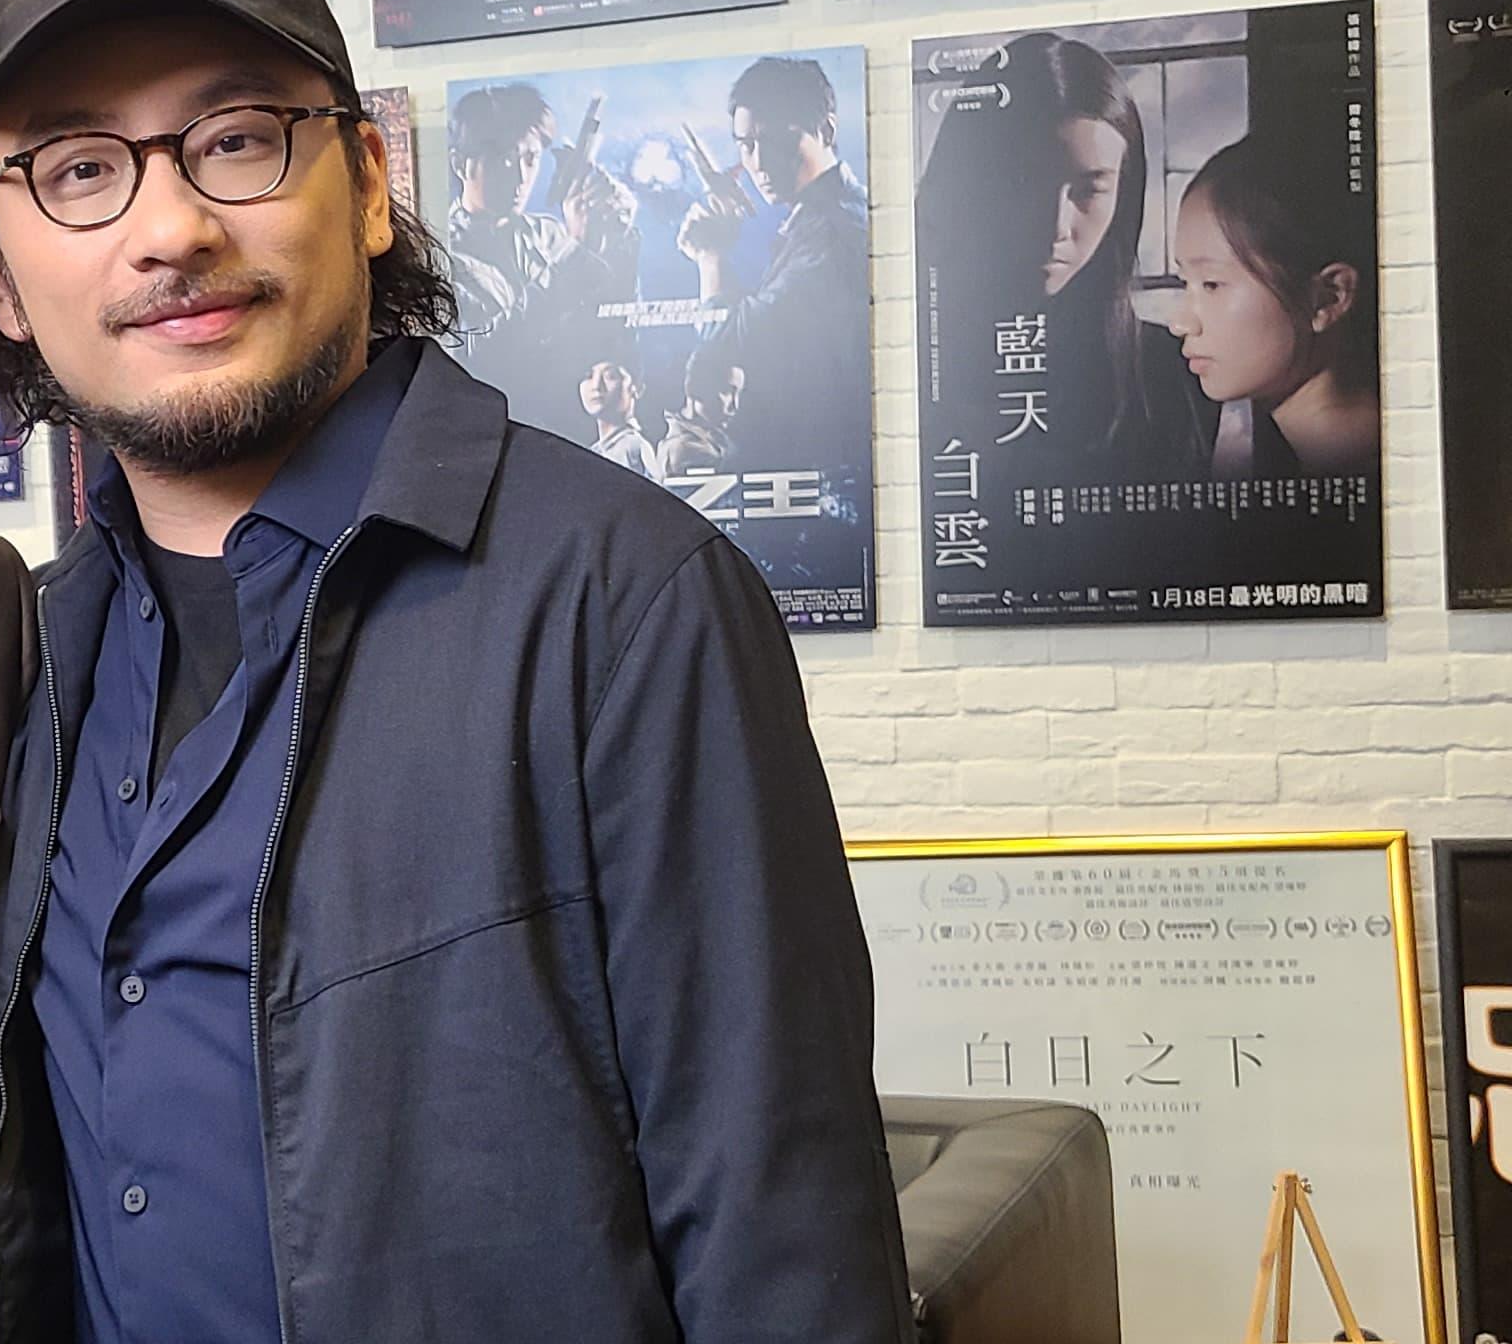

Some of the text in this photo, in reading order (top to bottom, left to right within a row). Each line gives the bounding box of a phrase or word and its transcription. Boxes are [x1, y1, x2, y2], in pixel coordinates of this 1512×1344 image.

[663, 467, 821, 521] 之王
[963, 1030, 1268, 1089] 白日之下
[1120, 1100, 1202, 1113] DAYLIGHT
